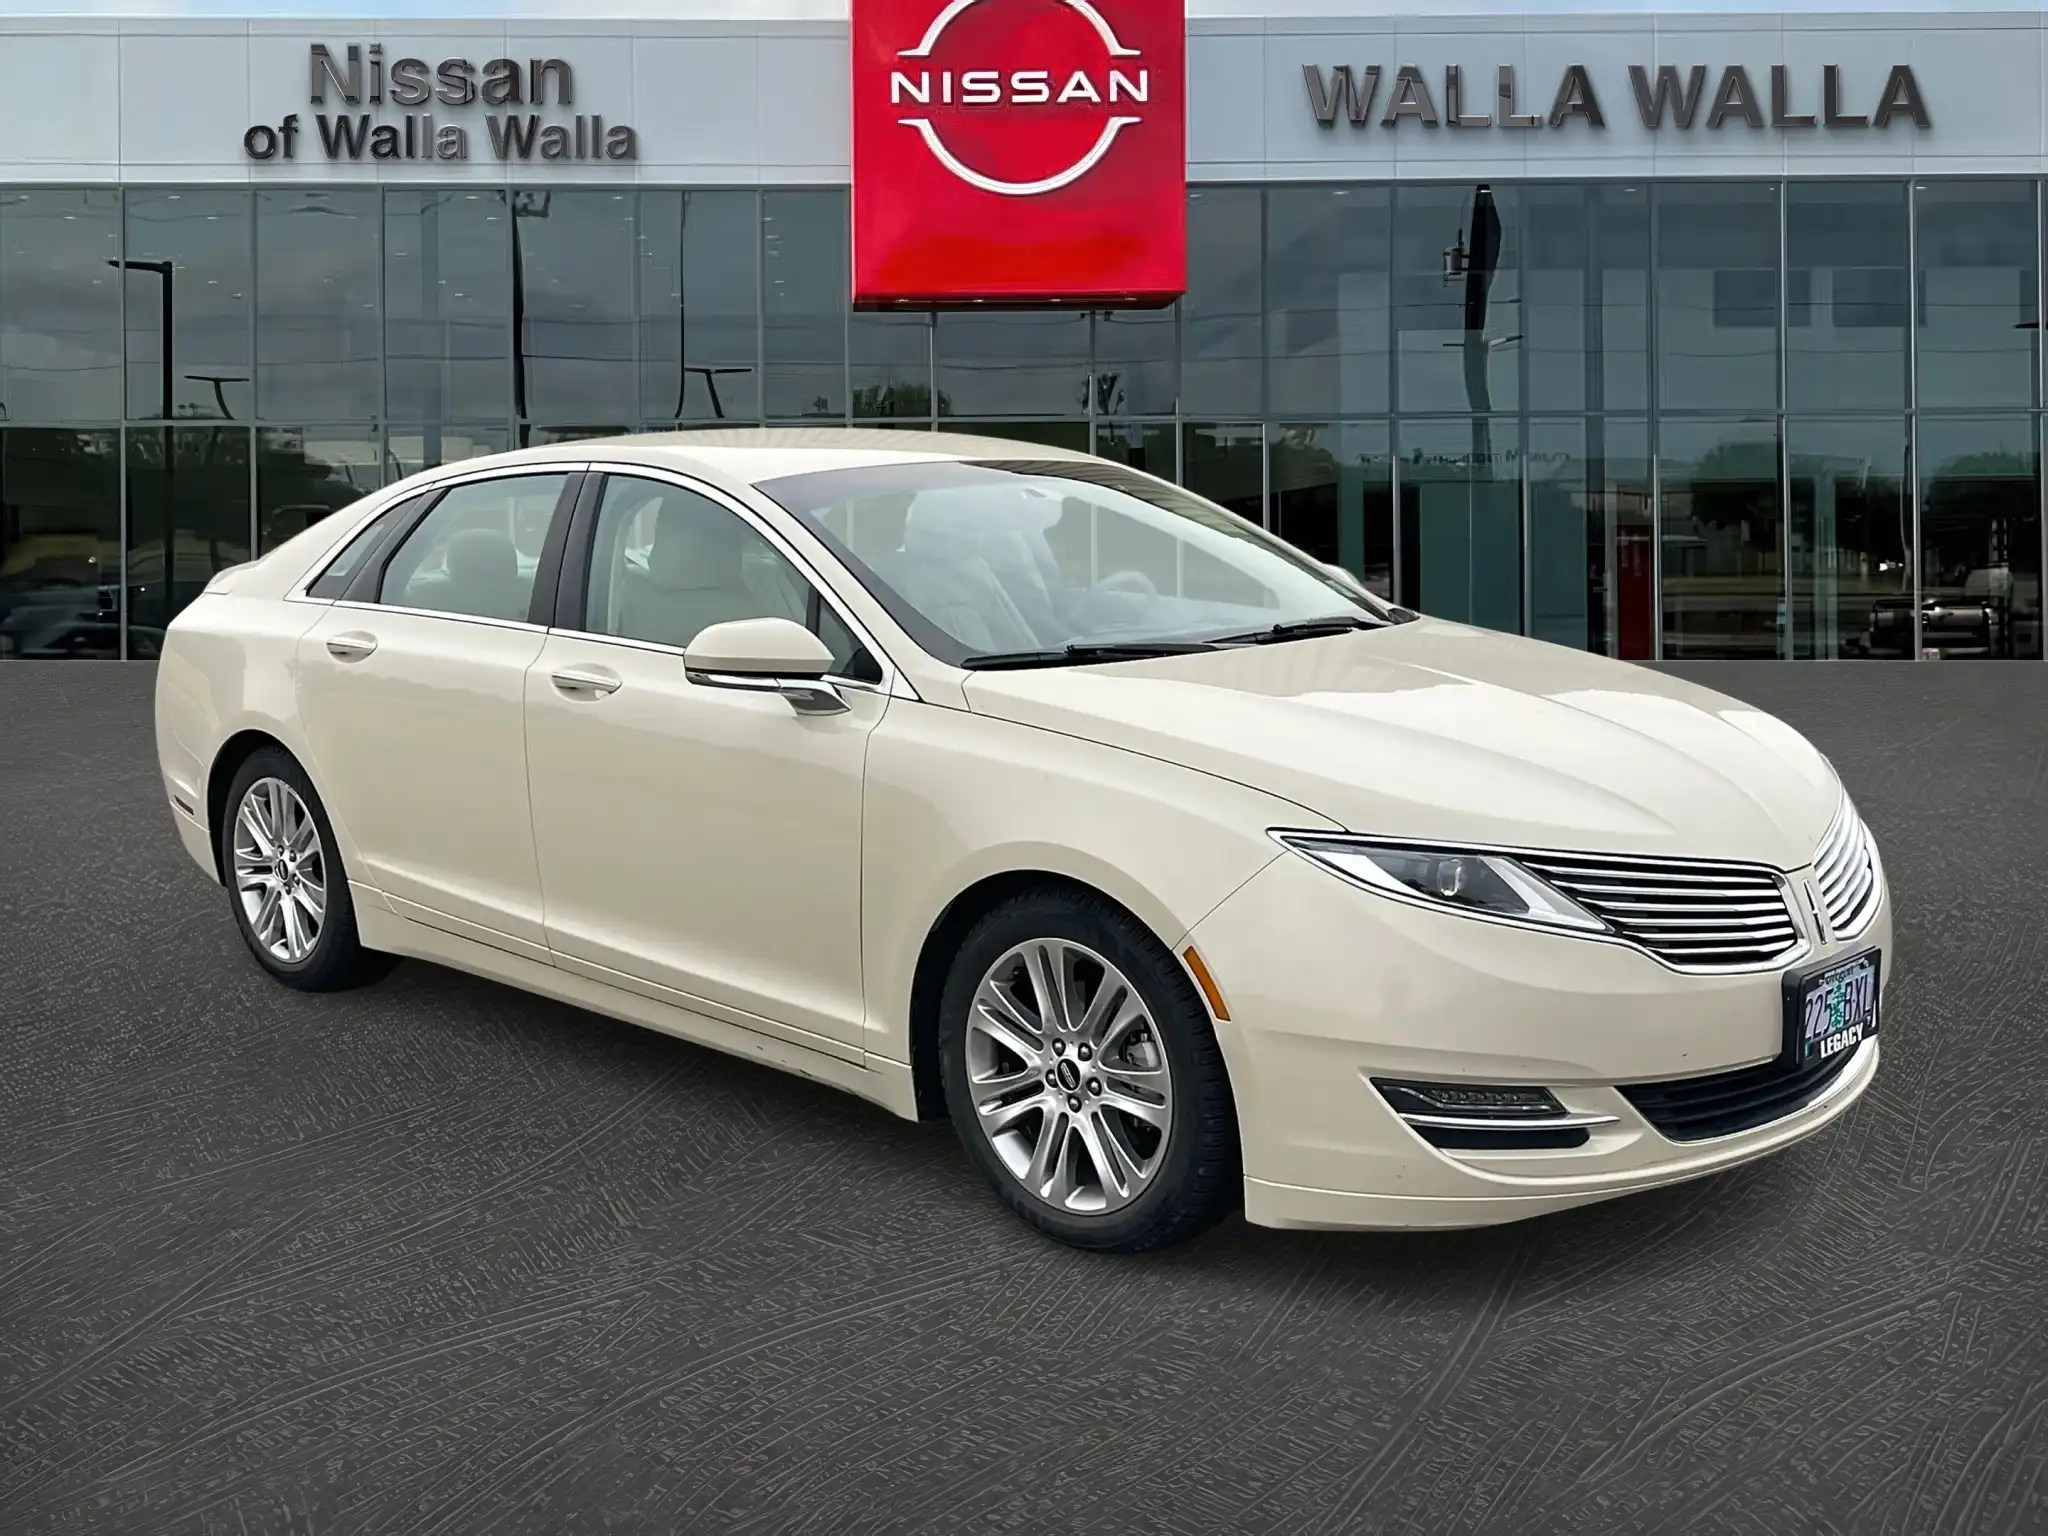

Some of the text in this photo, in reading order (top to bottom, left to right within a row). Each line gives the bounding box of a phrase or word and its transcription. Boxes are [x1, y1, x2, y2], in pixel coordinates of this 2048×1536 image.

[310, 42, 573, 105] Nissan
[890, 69, 1149, 104] NISSAN
[1302, 64, 1931, 128] WALLA WALLA
[243, 113, 636, 159] of Walla Walla
[1820, 1022, 1864, 1059] LEGACY
